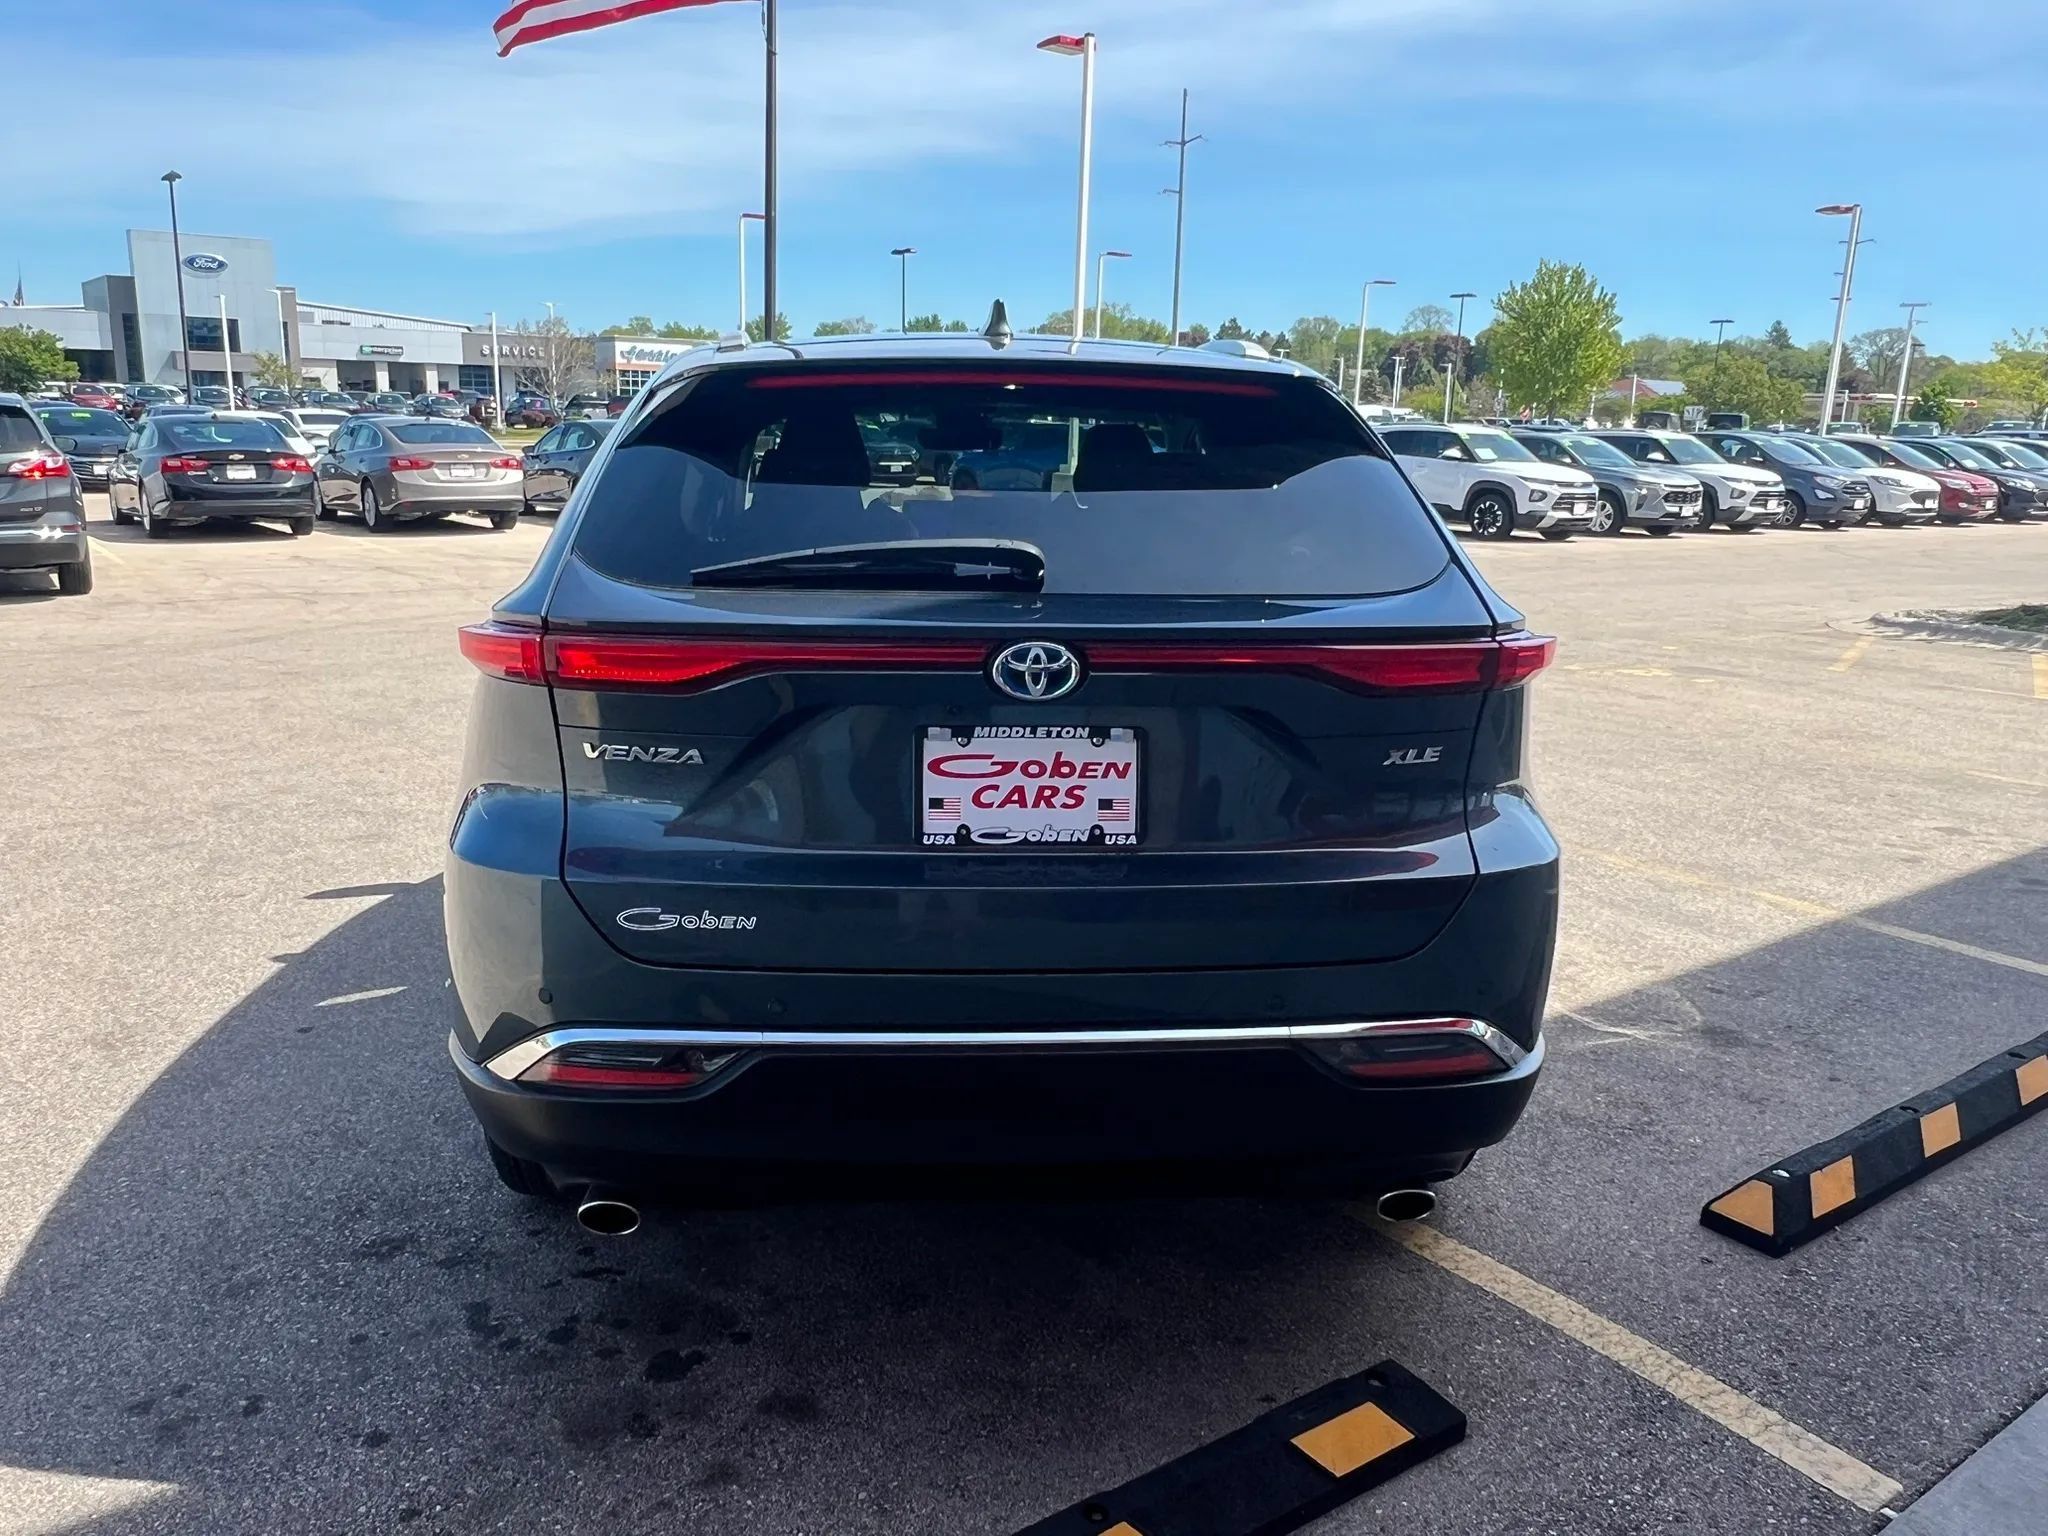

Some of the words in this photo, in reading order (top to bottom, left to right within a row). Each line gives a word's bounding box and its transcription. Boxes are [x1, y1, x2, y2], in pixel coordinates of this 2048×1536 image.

[973, 727, 1089, 738] MIDDLETON
[582, 742, 704, 764] VENZA
[1383, 746, 1443, 765] XLE
[971, 784, 1087, 809] CARS
[923, 835, 956, 845] USA
[1105, 835, 1137, 845] USA
